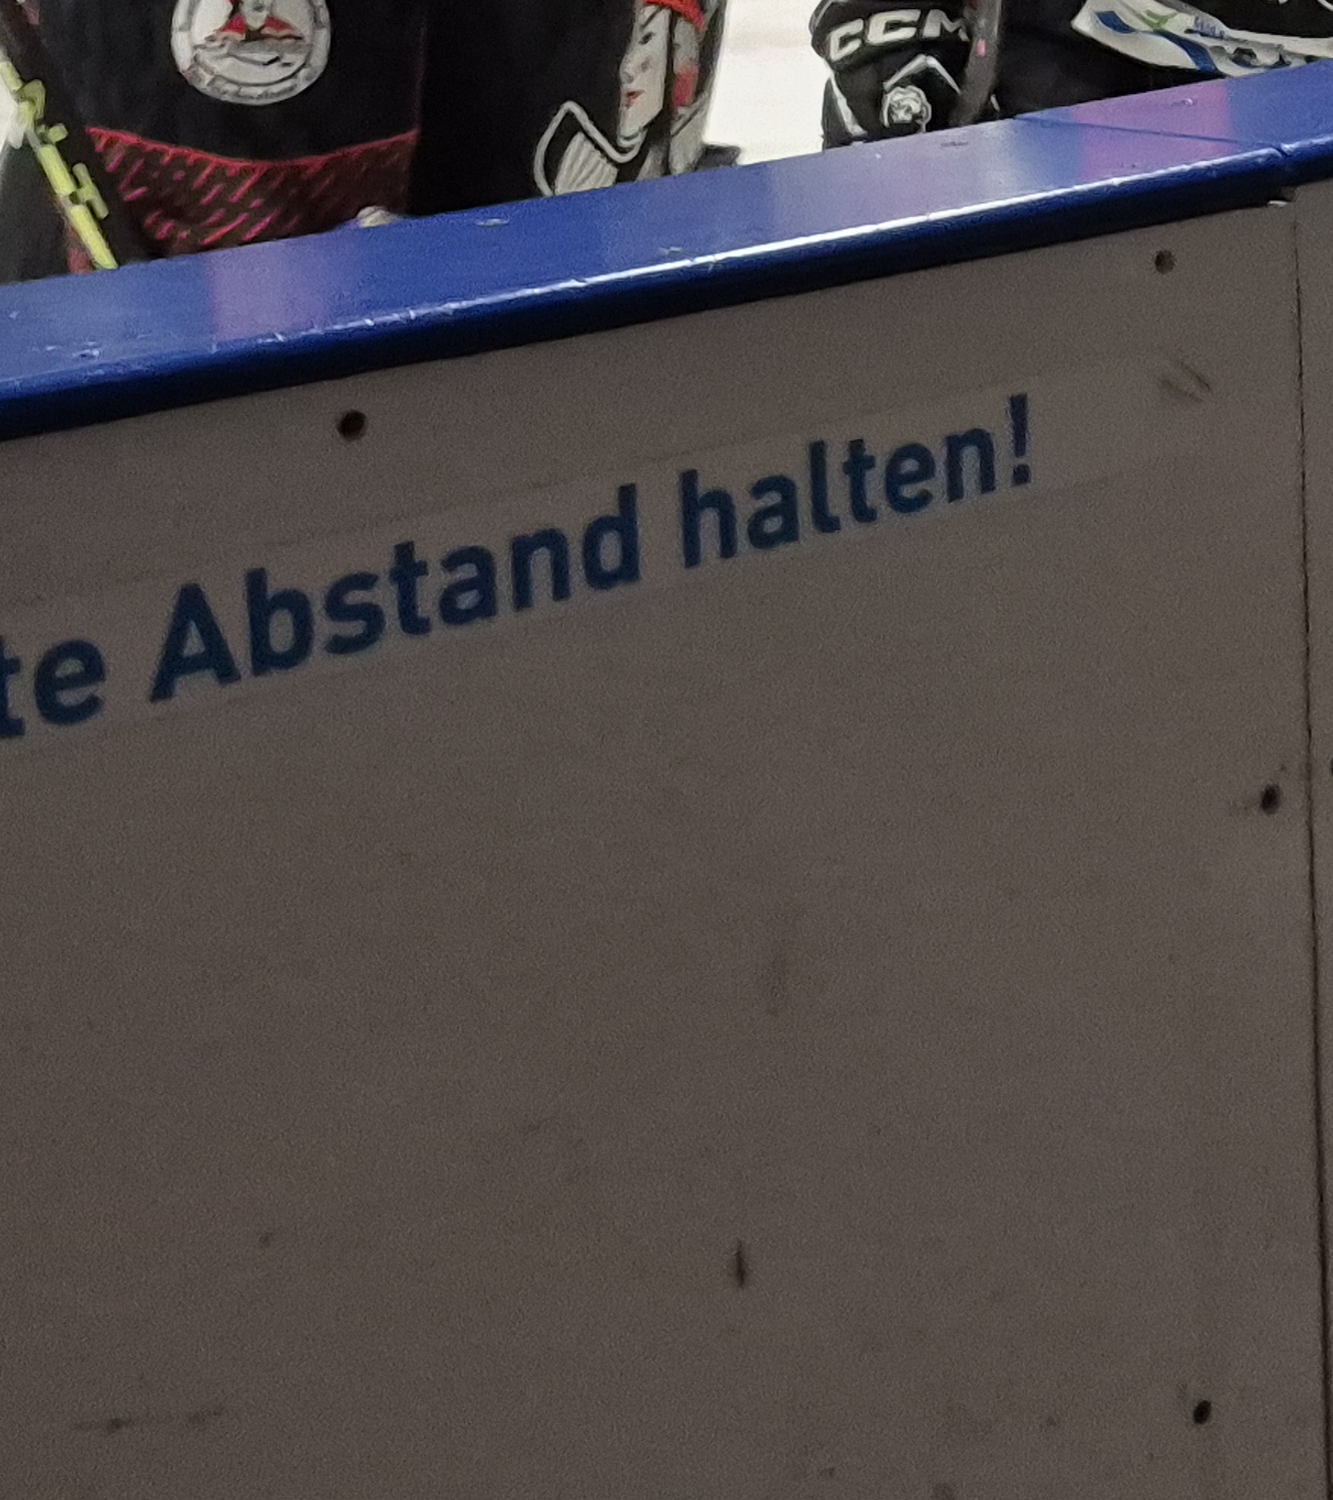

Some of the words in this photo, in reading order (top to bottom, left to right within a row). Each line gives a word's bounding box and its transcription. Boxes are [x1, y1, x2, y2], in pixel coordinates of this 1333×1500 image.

[828, 8, 972, 63] CCM
[149, 482, 643, 701] Abstand
[678, 392, 1033, 570] halten!
